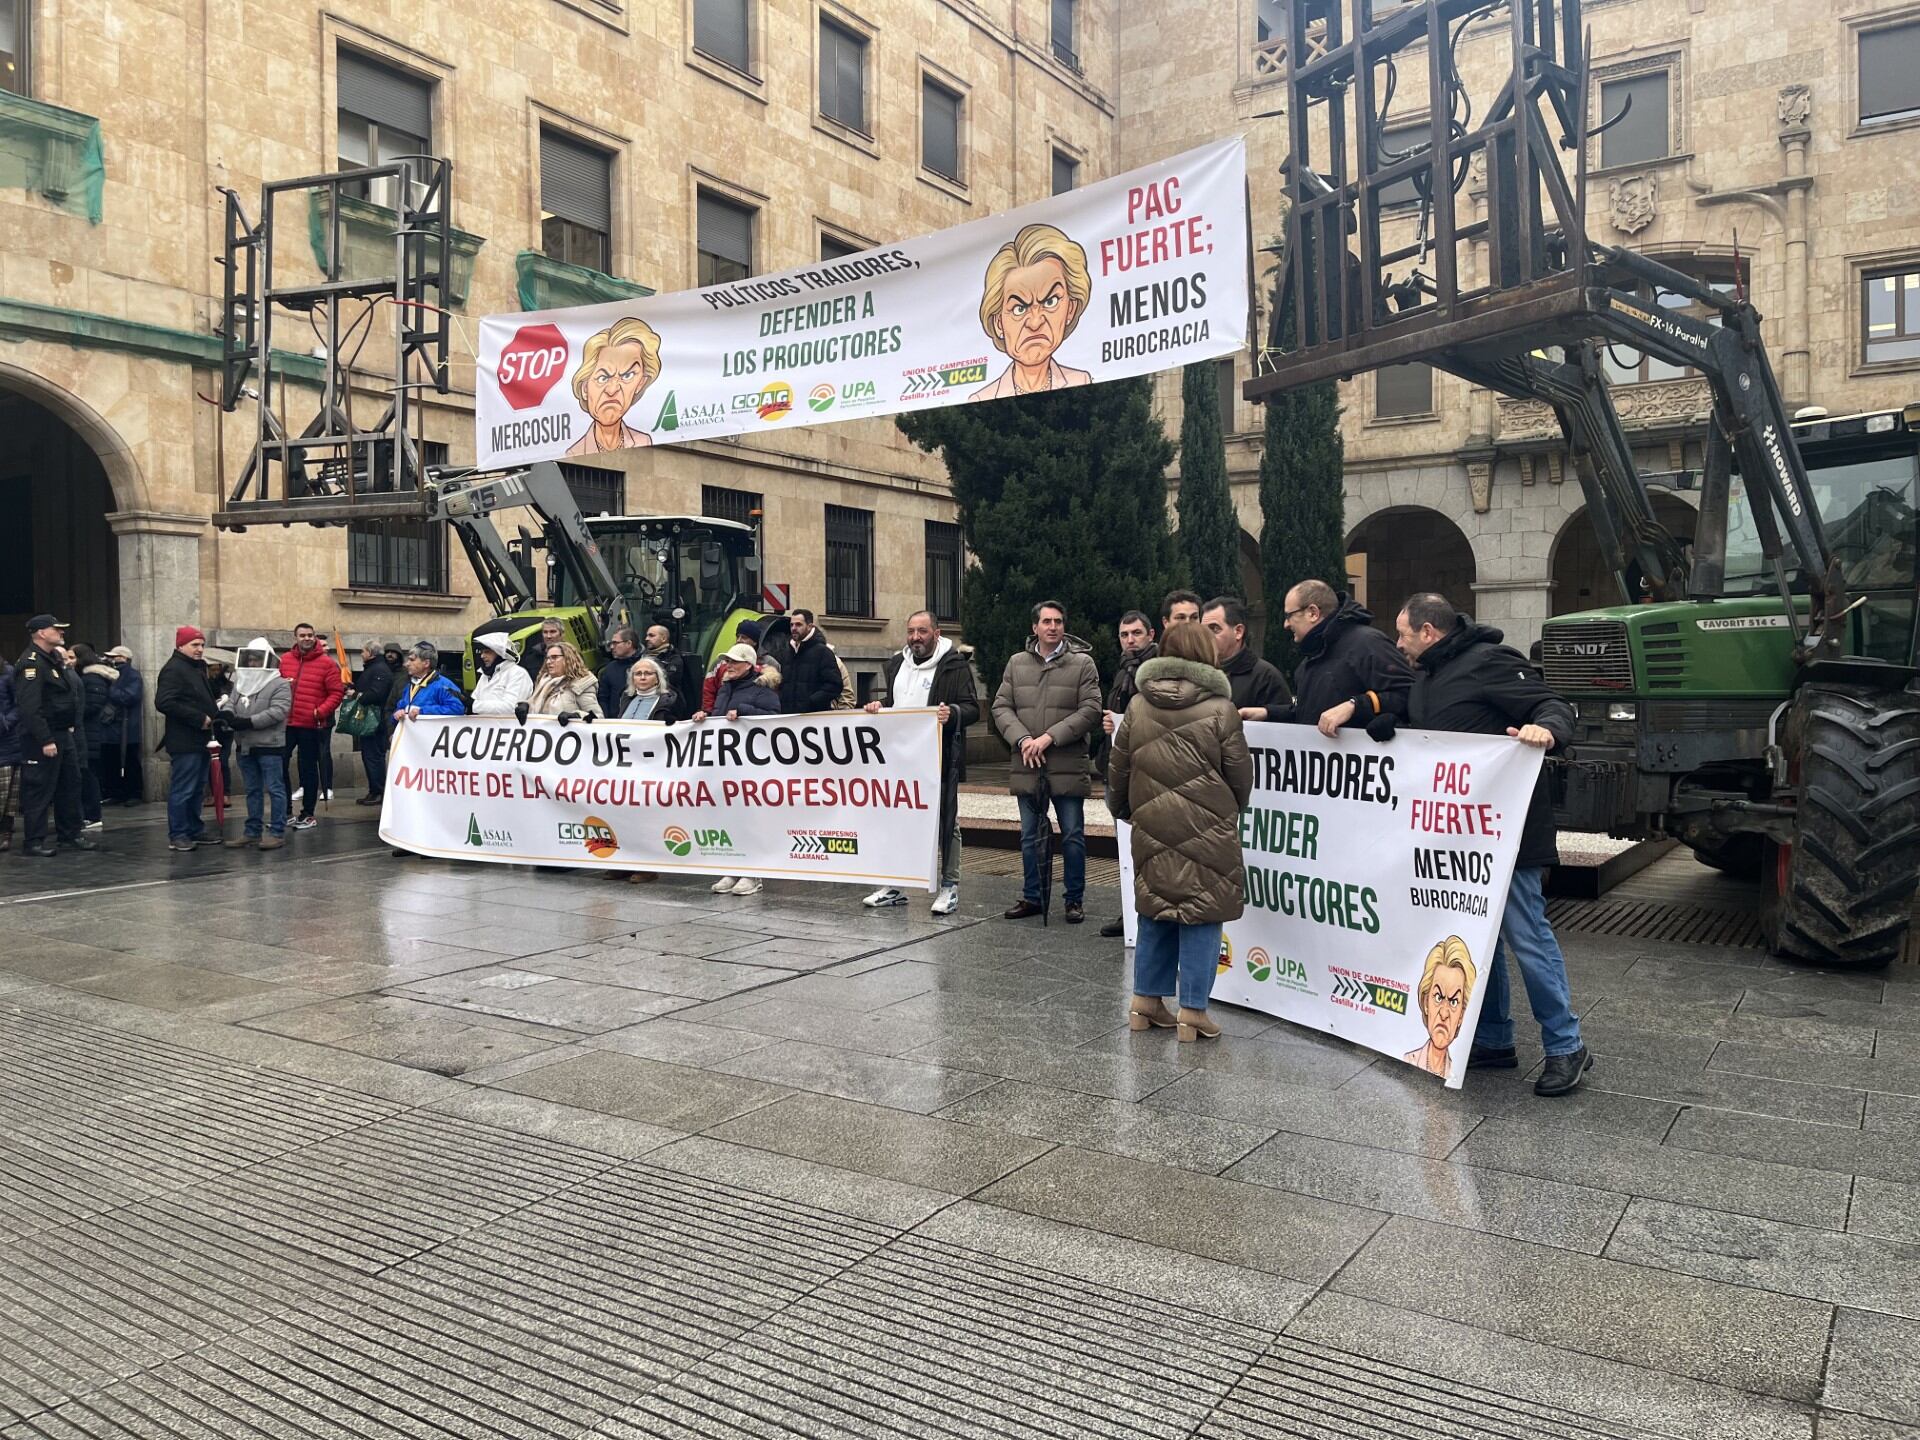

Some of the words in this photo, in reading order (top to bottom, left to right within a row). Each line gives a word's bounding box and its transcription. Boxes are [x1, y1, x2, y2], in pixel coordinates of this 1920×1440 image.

[1128, 176, 1181, 224] PAC
[1100, 215, 1213, 277] FUERTE;
[701, 278, 800, 310] POLÍTICOS
[795, 250, 920, 290] TRAIDORES,
[760, 295, 856, 337] DEFENDER
[862, 290, 875, 319] A
[1110, 272, 1207, 328] MENOS
[1102, 319, 1210, 363] BUROCRACIA
[1650, 315, 1674, 335] FX-16
[1675, 326, 1708, 350] Parallel
[500, 346, 567, 385] STOP
[722, 349, 757, 378] LOS
[763, 325, 902, 372] PRODUCTORES
[928, 364, 938, 372] DE
[940, 356, 989, 371] CAMPESINOS
[842, 381, 876, 399] UPA
[949, 367, 983, 385] UCCL
[732, 390, 790, 410] COAG
[900, 391, 925, 401] Castilla
[680, 402, 726, 420] ASAJA
[680, 416, 725, 428] SALAMANCA
[491, 412, 571, 453] MERCOSUR
[1770, 443, 1802, 517] HOWARD
[1703, 619, 1745, 629] FAVORIT
[1749, 618, 1768, 627] 514
[1770, 618, 1776, 626] C
[431, 725, 582, 766] ACUERDO
[592, 732, 632, 768] UE
[664, 726, 885, 768] MERCOSUR
[395, 766, 480, 796] MUERTE
[486, 772, 514, 799] DE
[521, 773, 551, 800] LA
[554, 777, 716, 808] APICULTURA
[722, 777, 928, 810] PROFESIONAL
[1249, 747, 1398, 811] TRAIDORES,
[1433, 762, 1471, 795] PAC
[559, 823, 611, 839] COAG
[1411, 799, 1502, 840] FUERTE;
[483, 829, 512, 841] ASAJA
[694, 829, 733, 847] UPA
[819, 830, 858, 838] CAMPESINOS
[828, 839, 855, 854] UCCL
[789, 853, 829, 861] SALAMANCA
[1413, 847, 1493, 885] MENOS
[1410, 887, 1489, 918] BUROCRACIA
[1276, 956, 1308, 982] UPA
[1352, 970, 1362, 981] DE
[1364, 974, 1411, 993] CAMPESINOS
[1330, 994, 1354, 1008] Castilla
[1376, 988, 1404, 1013] UCCL
